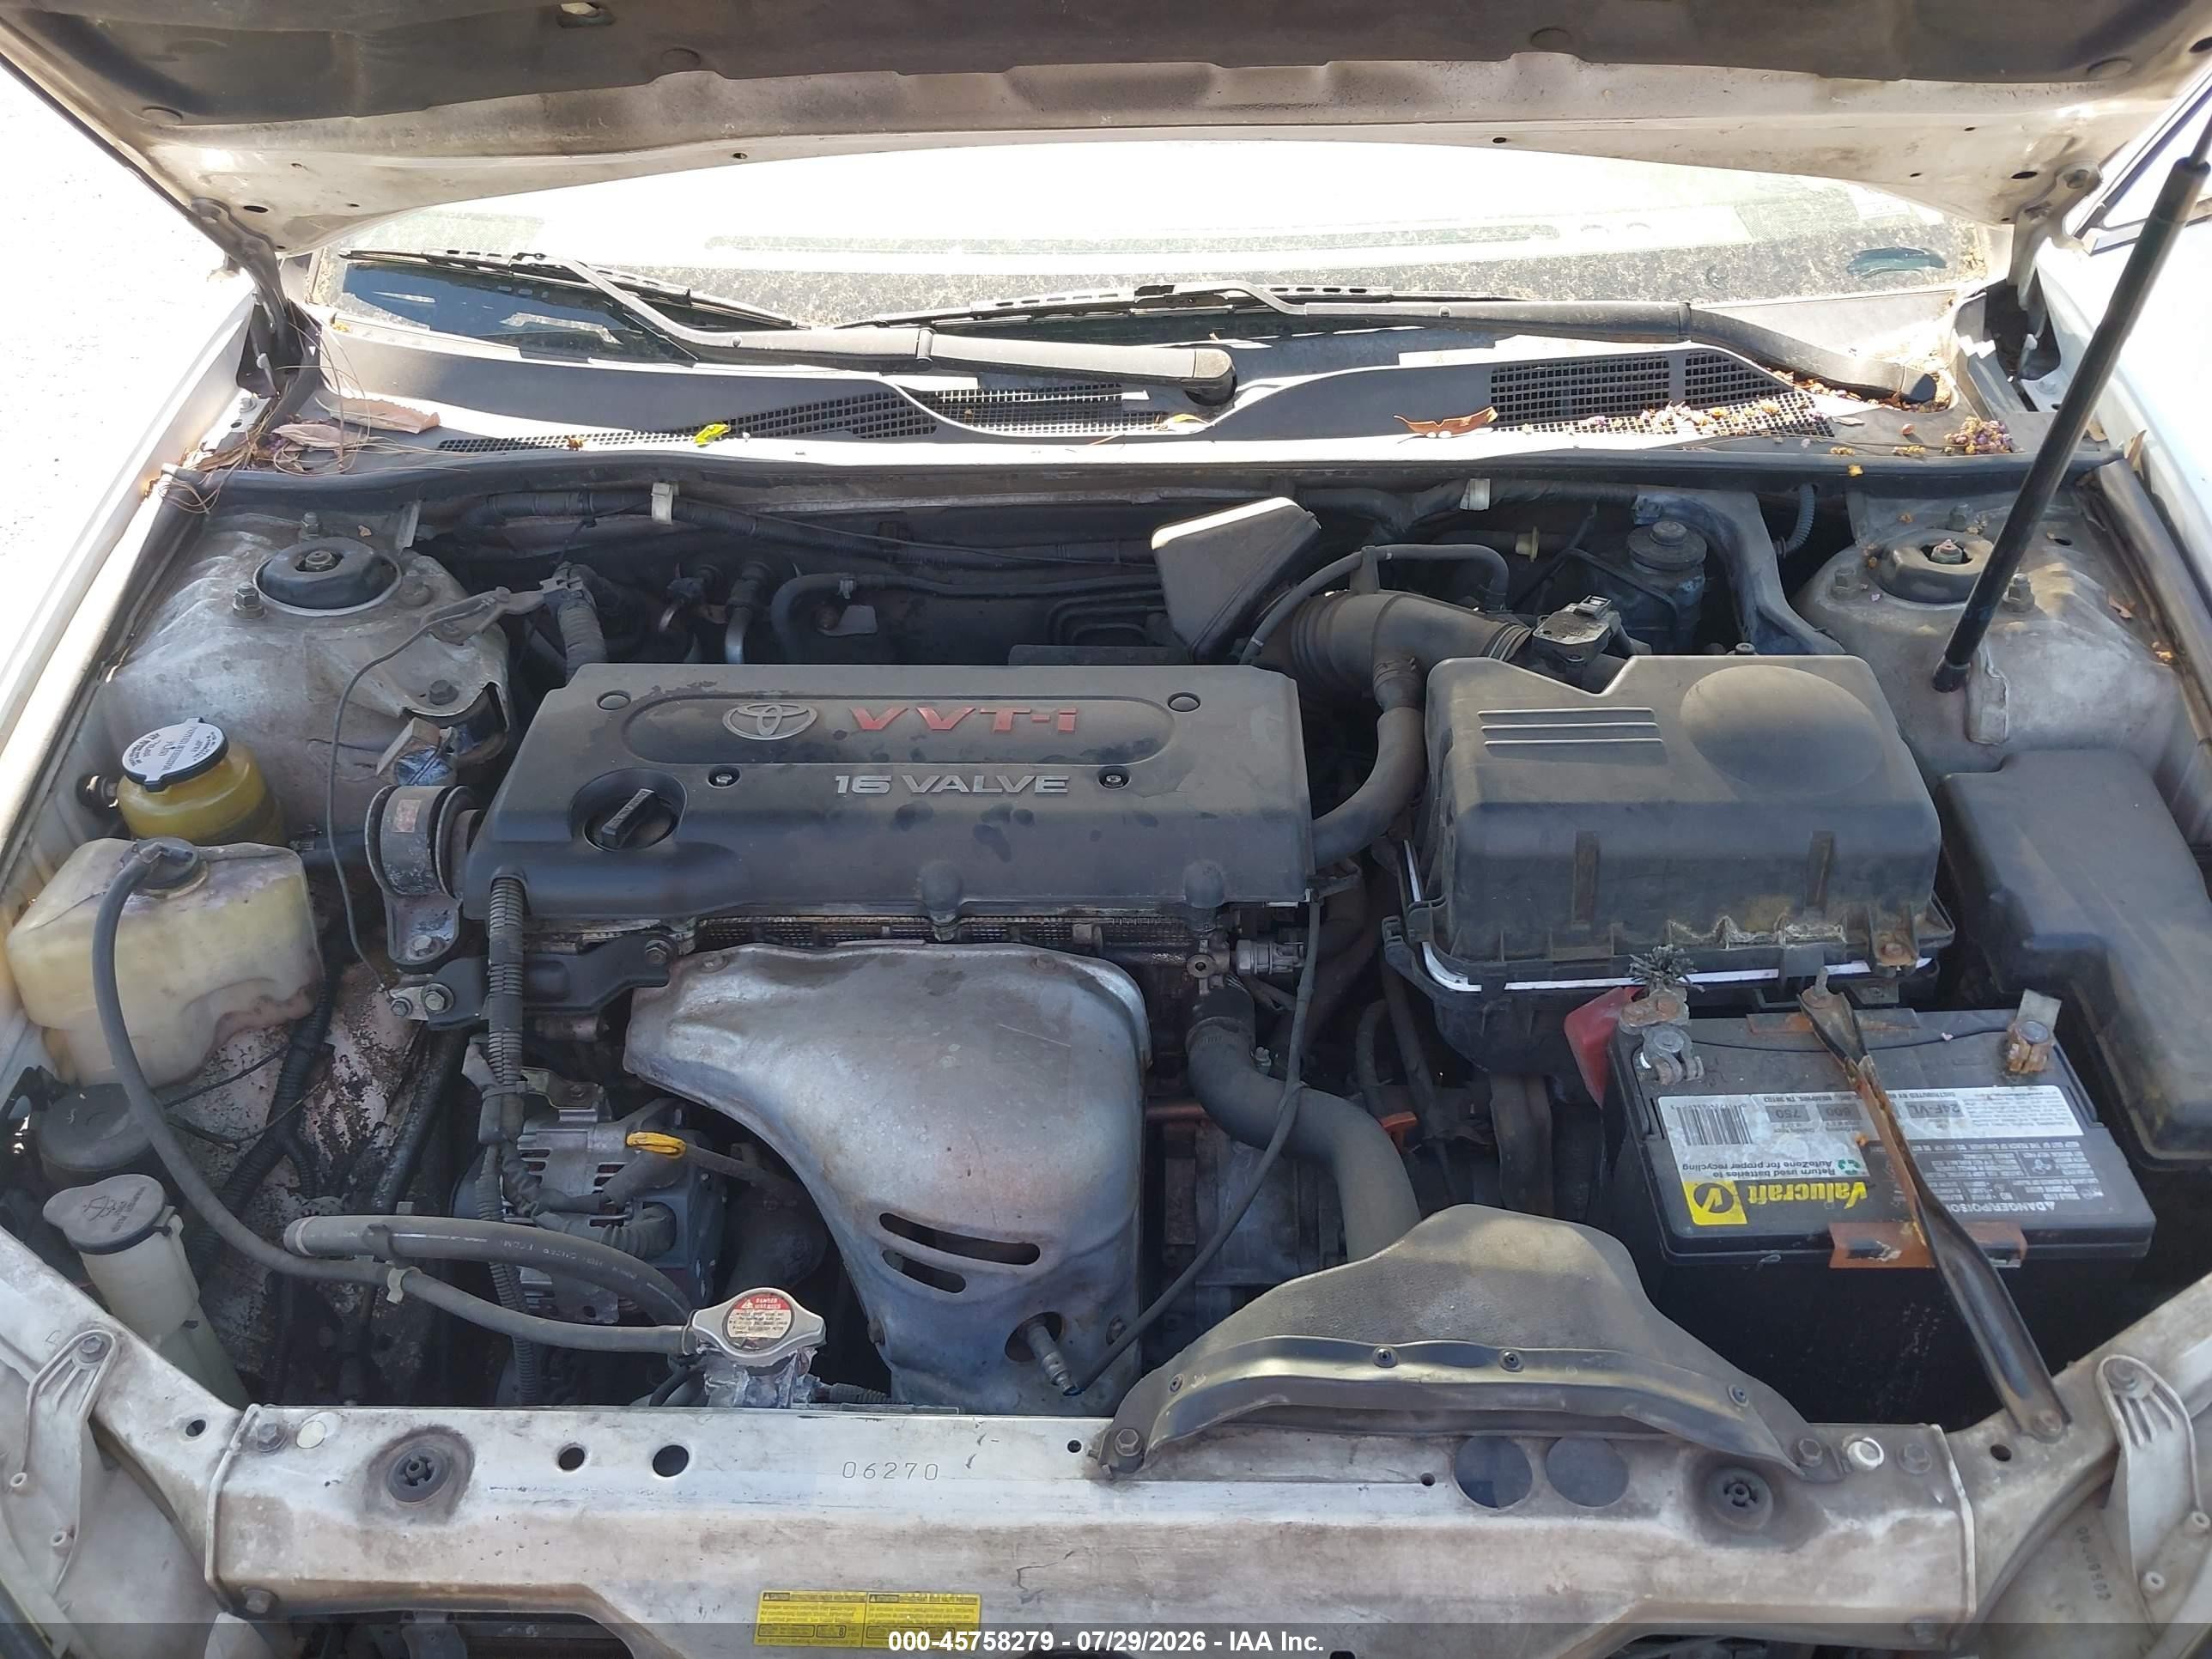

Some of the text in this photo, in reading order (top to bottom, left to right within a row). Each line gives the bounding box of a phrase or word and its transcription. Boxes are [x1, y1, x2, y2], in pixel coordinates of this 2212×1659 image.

[850, 707, 1078, 732] VVT-i
[836, 775, 1070, 794] 16 VALVE
[1775, 1109, 1802, 1119] 750
[1911, 1103, 1960, 1115] 24F-VL
[1682, 1160, 1833, 1172] AutoZone for proper recycling
[1800, 1167, 1836, 1177] Return
[1726, 1170, 1771, 1178] batteries
[1773, 1169, 1798, 1177] used
[1747, 1180, 1869, 1210] Valucraft
[842, 1462, 939, 1480] 06270
